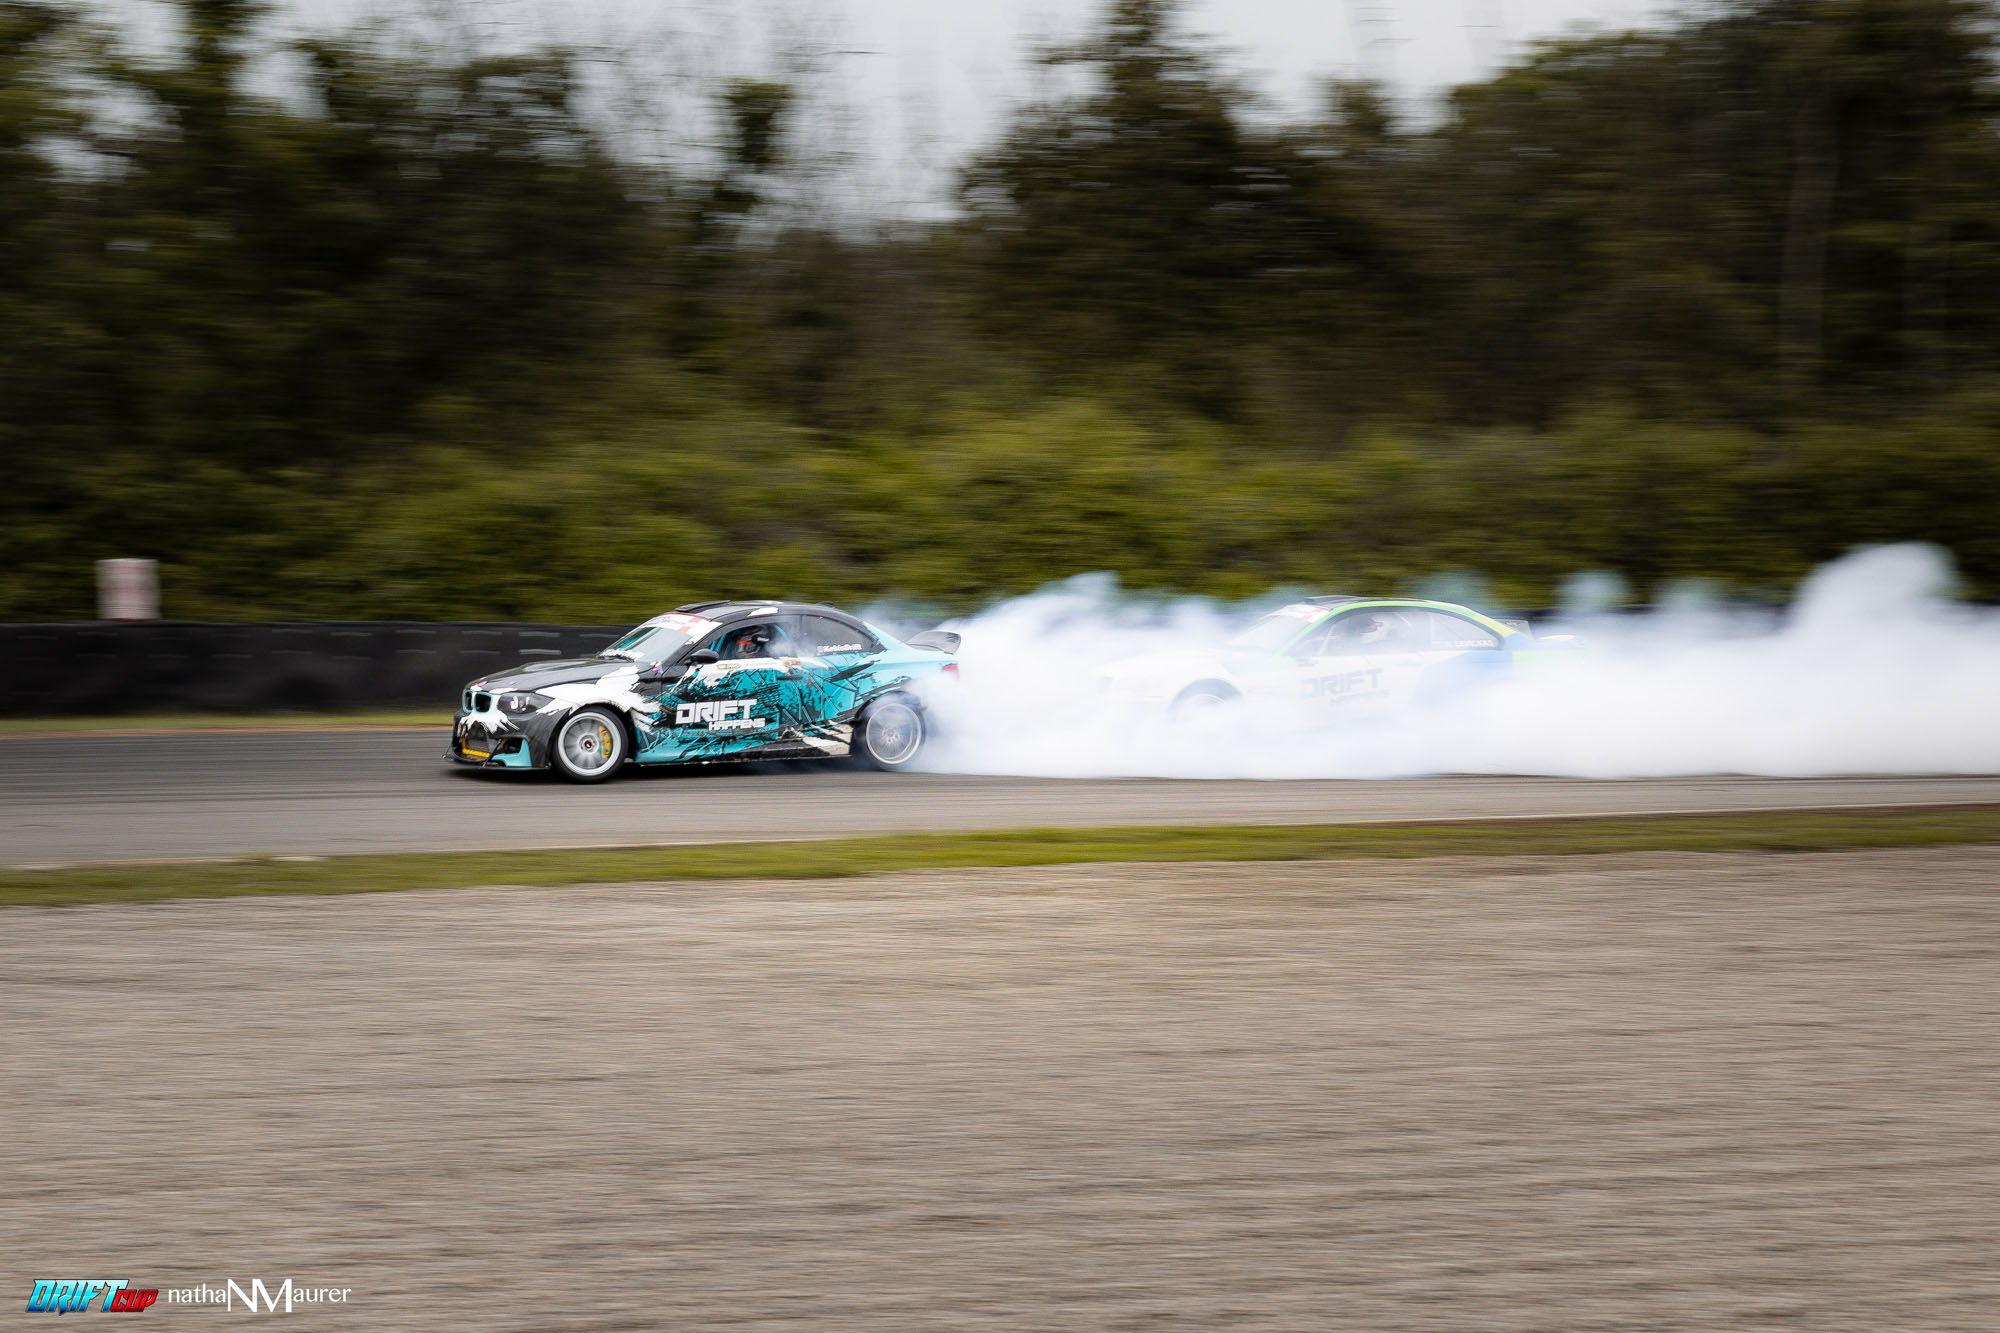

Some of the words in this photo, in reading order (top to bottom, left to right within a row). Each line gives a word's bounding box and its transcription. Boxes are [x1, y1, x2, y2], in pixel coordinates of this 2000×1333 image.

[1299, 667, 1384, 699] DRIFT
[675, 699, 758, 725] DRIFT
[708, 717, 766, 731] HAPPENS
